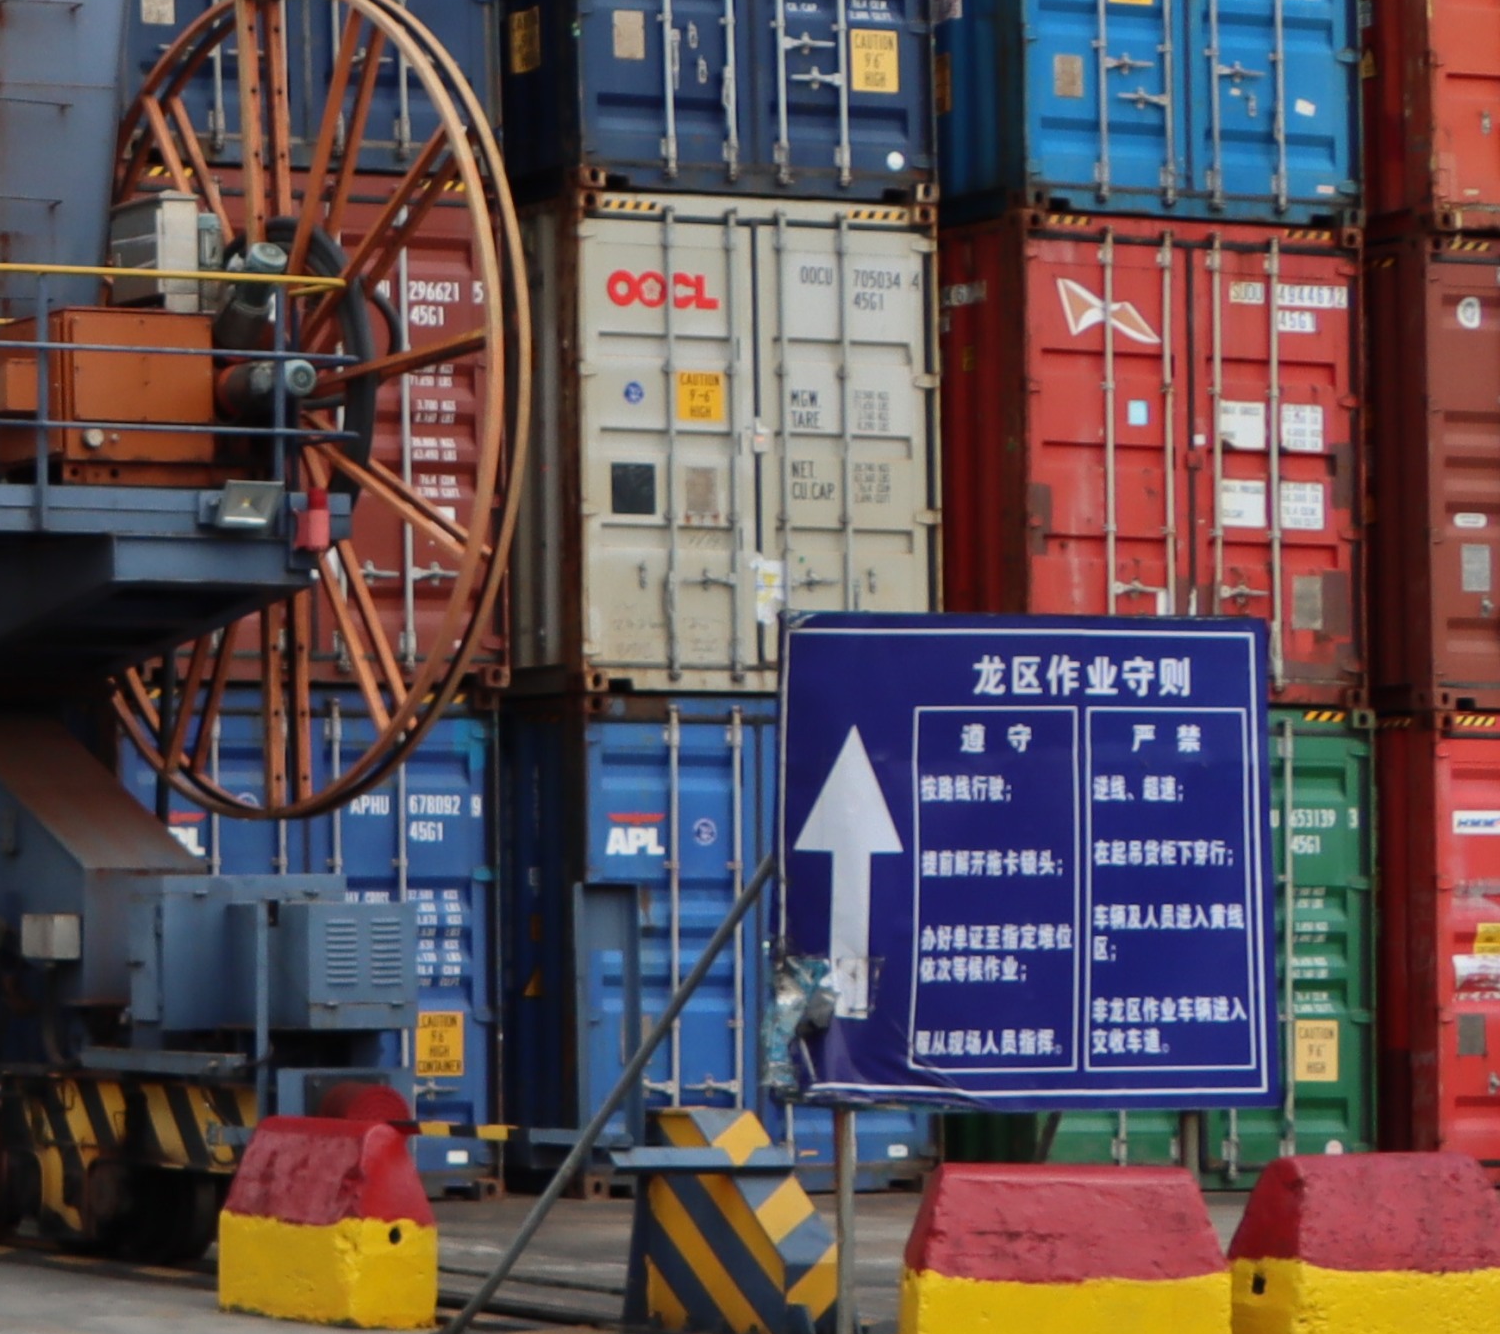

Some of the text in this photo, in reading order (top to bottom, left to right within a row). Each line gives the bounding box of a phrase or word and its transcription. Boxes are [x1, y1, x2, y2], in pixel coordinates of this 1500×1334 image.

[854, 33, 895, 50] CAUTION
[864, 69, 887, 88] HIGH
[800, 266, 920, 291] OOCU 705034 4
[408, 280, 484, 304] 296621 5
[607, 270, 720, 310] OOCL
[852, 292, 885, 311] 45G1
[409, 305, 445, 326] 45G1
[679, 372, 720, 387] CAUTION
[690, 405, 712, 418] HIGH
[973, 654, 1192, 696] 龙区作业守则
[351, 794, 482, 818] APHU 678092 9
[1349, 808, 1359, 829] 3
[409, 821, 444, 842] 45G1
[607, 826, 664, 855] APL
[1291, 834, 1322, 854] 45G1
[421, 1015, 458, 1028] CAUTION
[429, 1046, 450, 1058] HIGH
[418, 1061, 462, 1074] CONTAINER
